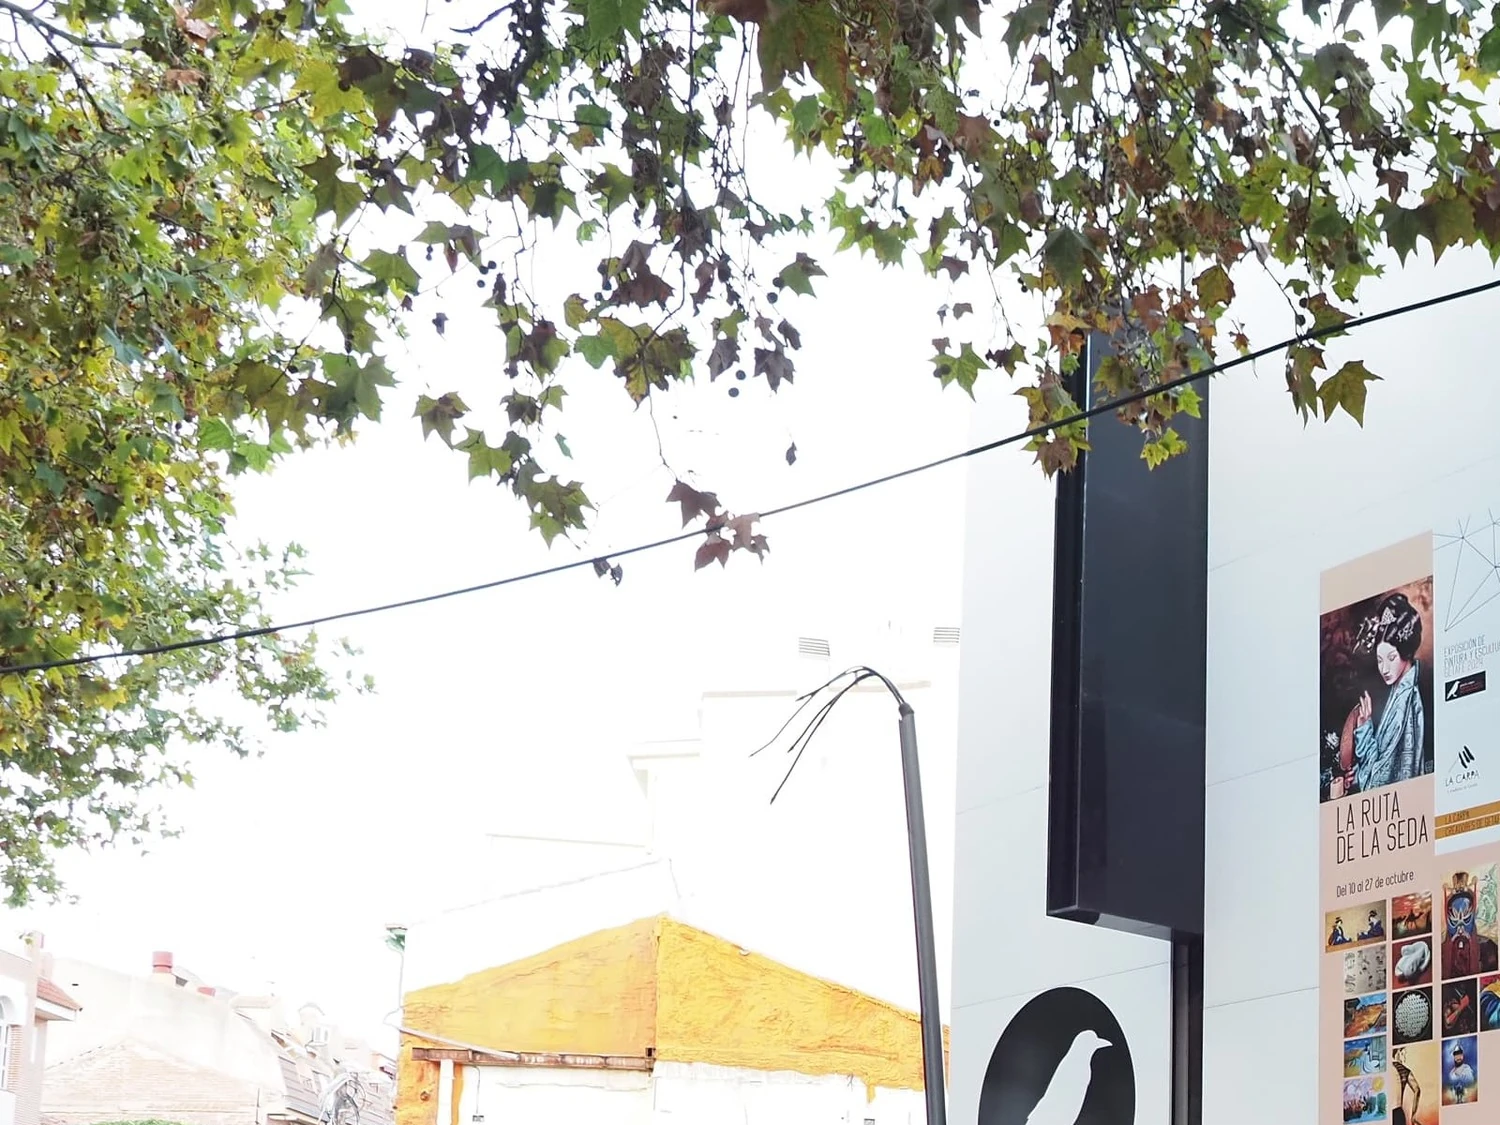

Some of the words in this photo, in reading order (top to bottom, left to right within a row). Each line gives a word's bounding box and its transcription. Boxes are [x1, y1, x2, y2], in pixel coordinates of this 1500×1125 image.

[1337, 803, 1355, 834] LA
[1362, 791, 1400, 827] RUTA
[1337, 833, 1355, 864] DE
[1362, 827, 1380, 858] LA
[1387, 814, 1428, 851] SEDA
[1337, 885, 1347, 898] Del
[1348, 882, 1355, 894] 10
[1357, 881, 1364, 893] al
[1365, 878, 1373, 891] 27
[1375, 876, 1384, 888] de
[1386, 870, 1414, 886] octubre
